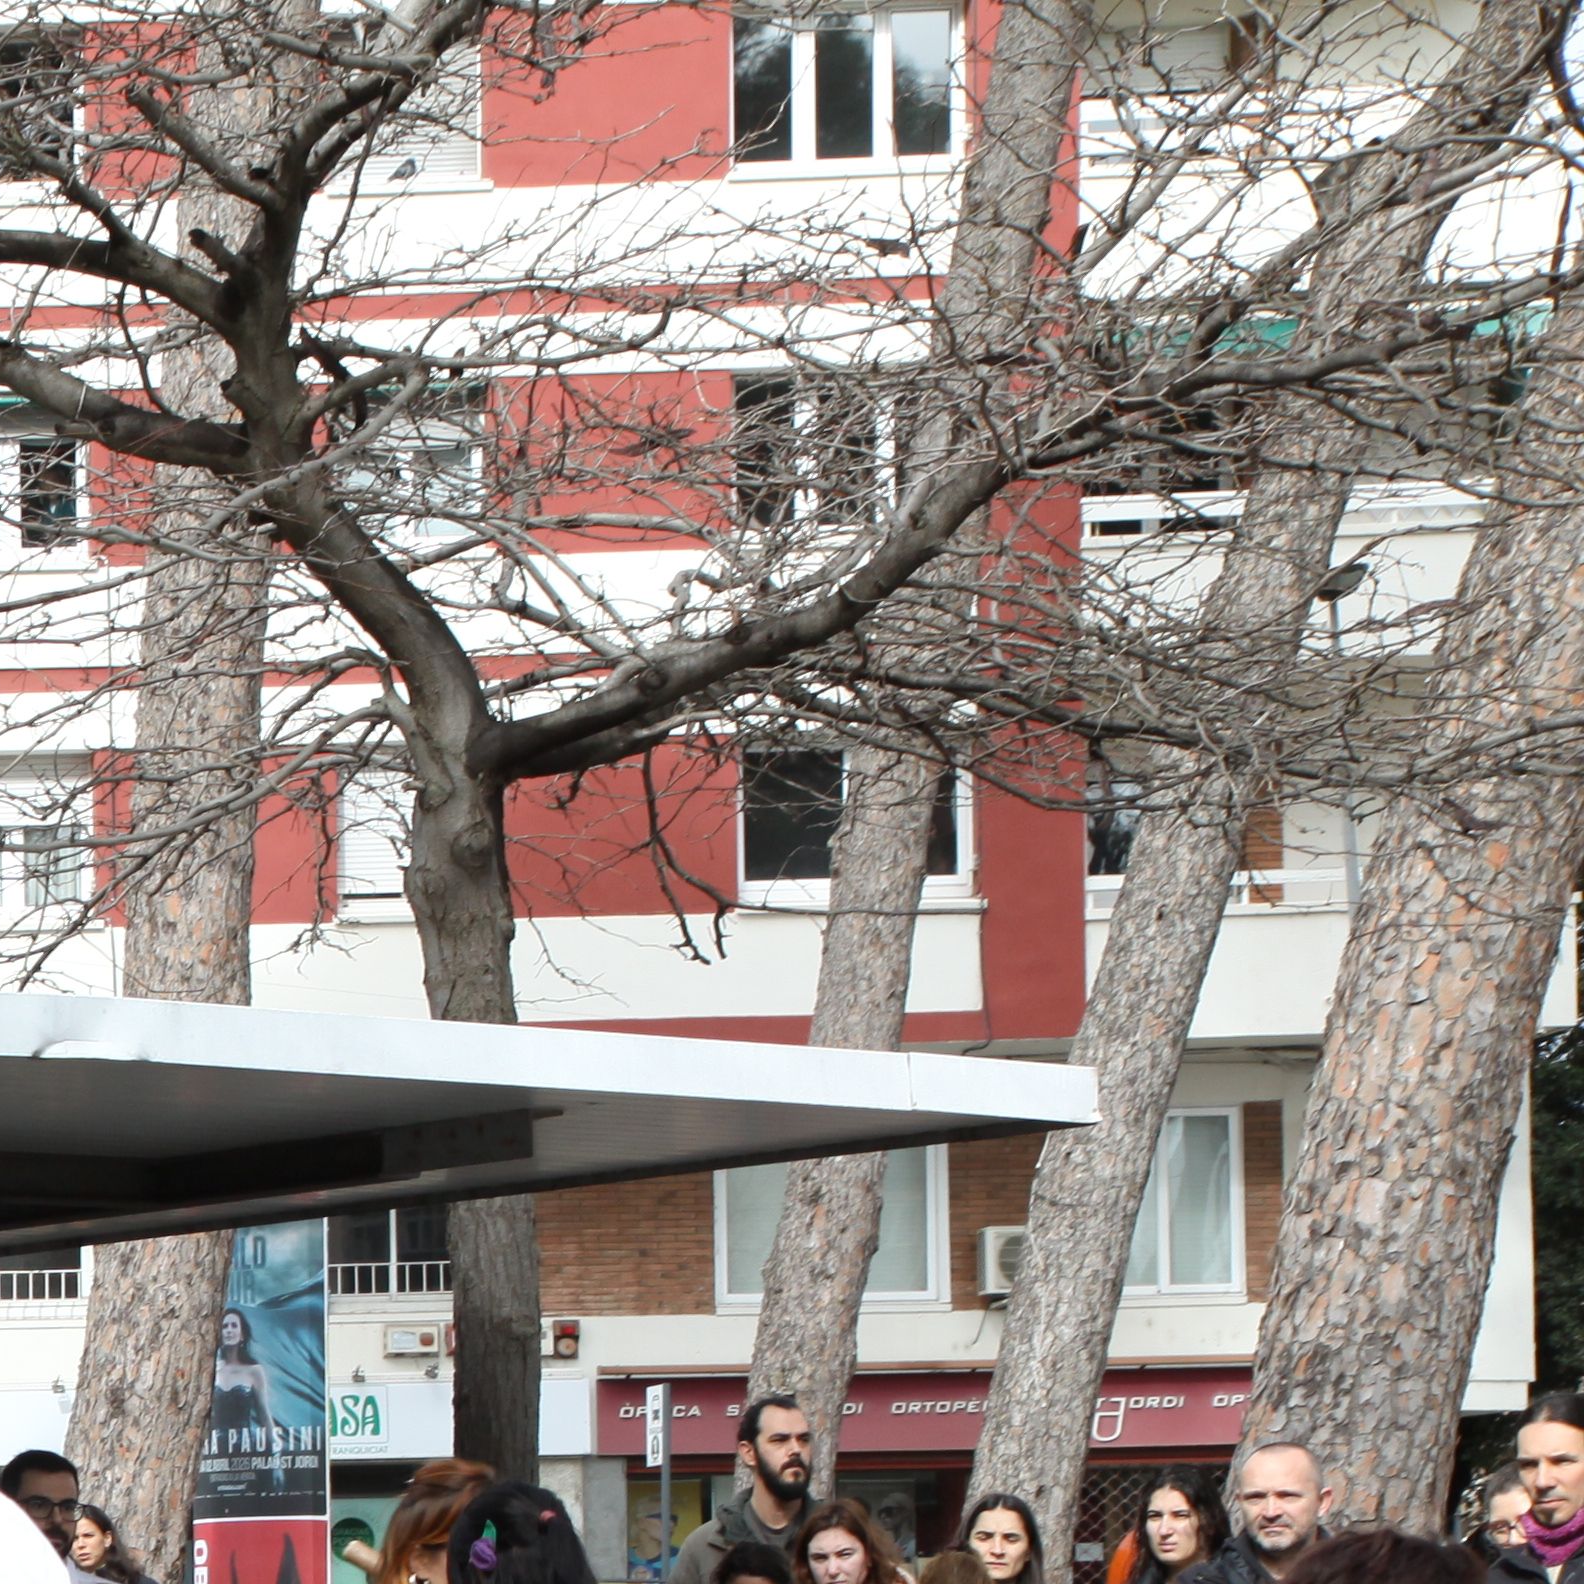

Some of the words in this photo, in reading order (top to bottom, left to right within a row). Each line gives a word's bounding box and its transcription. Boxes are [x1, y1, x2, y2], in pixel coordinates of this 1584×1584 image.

[619, 1402, 702, 1418] ÒPCA
[228, 1425, 321, 1454] PAUSINI
[330, 1445, 389, 1455] RANQUICIAT
